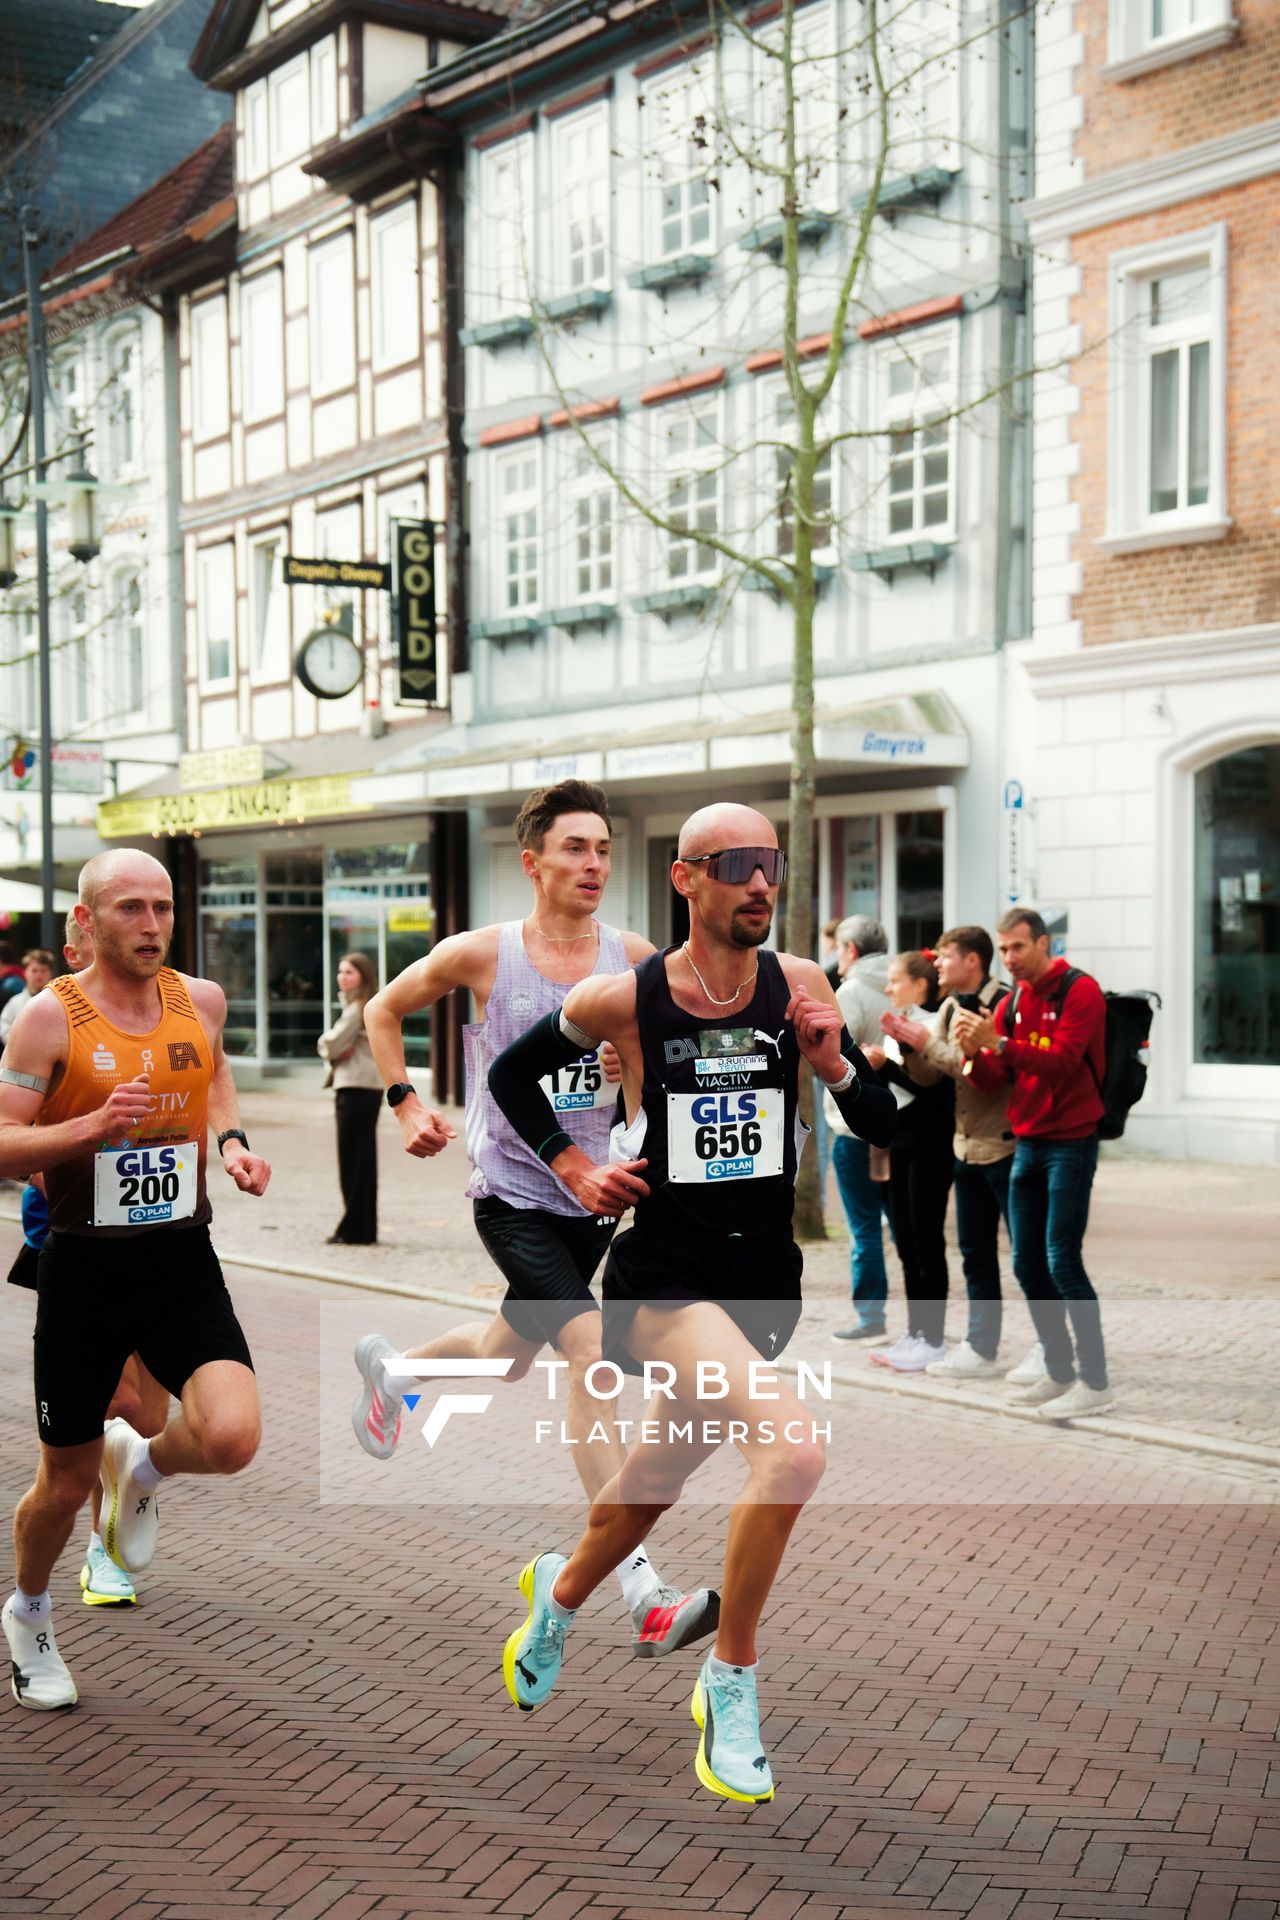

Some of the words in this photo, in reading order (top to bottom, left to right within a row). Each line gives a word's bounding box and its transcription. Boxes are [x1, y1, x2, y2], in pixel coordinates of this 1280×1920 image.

[403, 530, 432, 661] GOLD
[695, 1073, 751, 1087] VIACTIV
[571, 1095, 593, 1103] PLAN
[695, 1121, 762, 1160] 656
[726, 1161, 752, 1171] PLAN
[118, 1172, 179, 1206] 200
[147, 1206, 171, 1216] PLAN
